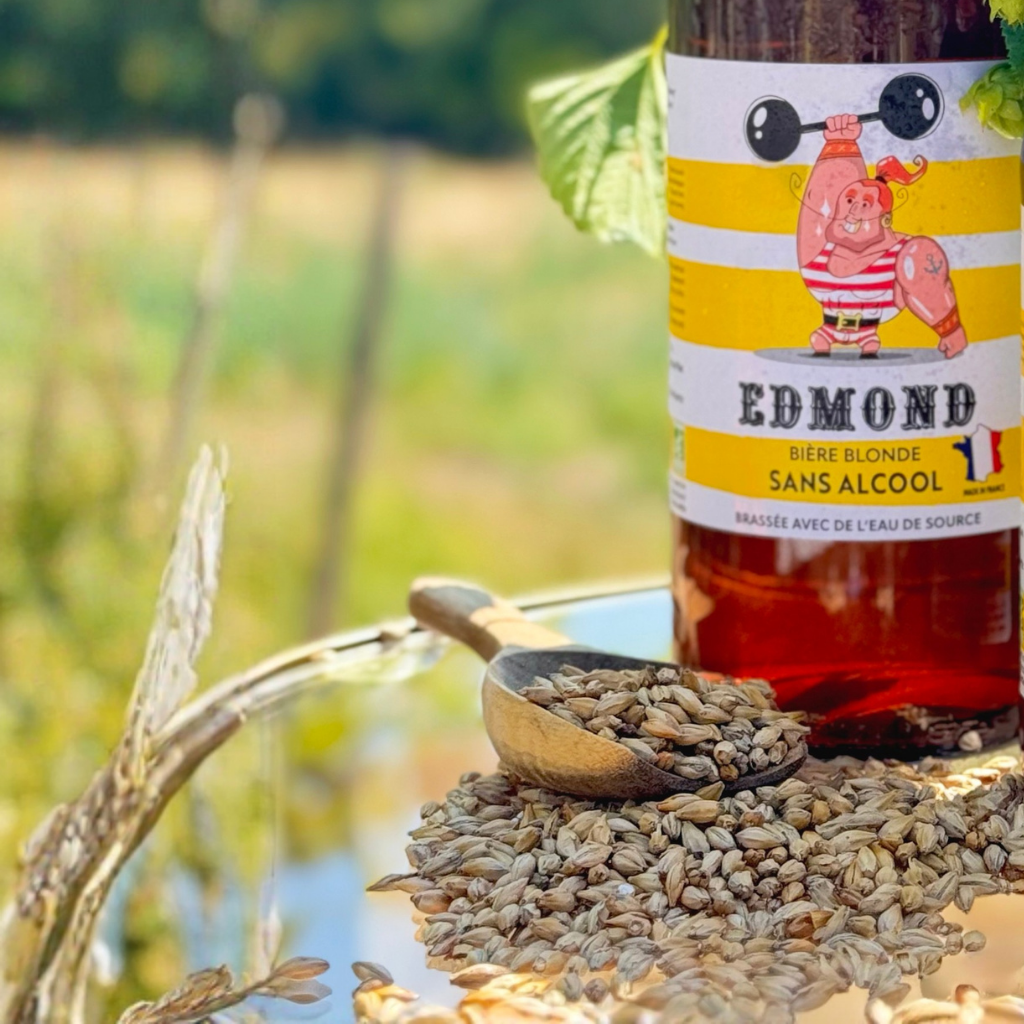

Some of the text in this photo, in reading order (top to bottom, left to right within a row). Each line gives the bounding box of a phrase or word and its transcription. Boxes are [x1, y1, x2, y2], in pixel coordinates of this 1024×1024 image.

[739, 381, 976, 432] EDMOND
[789, 443, 921, 463] BIÈRE BLONDE
[769, 470, 943, 495] SANS ALCOOL
[735, 512, 982, 533] BRASSÉE AVEC DE L'EAU DE SOURCE
